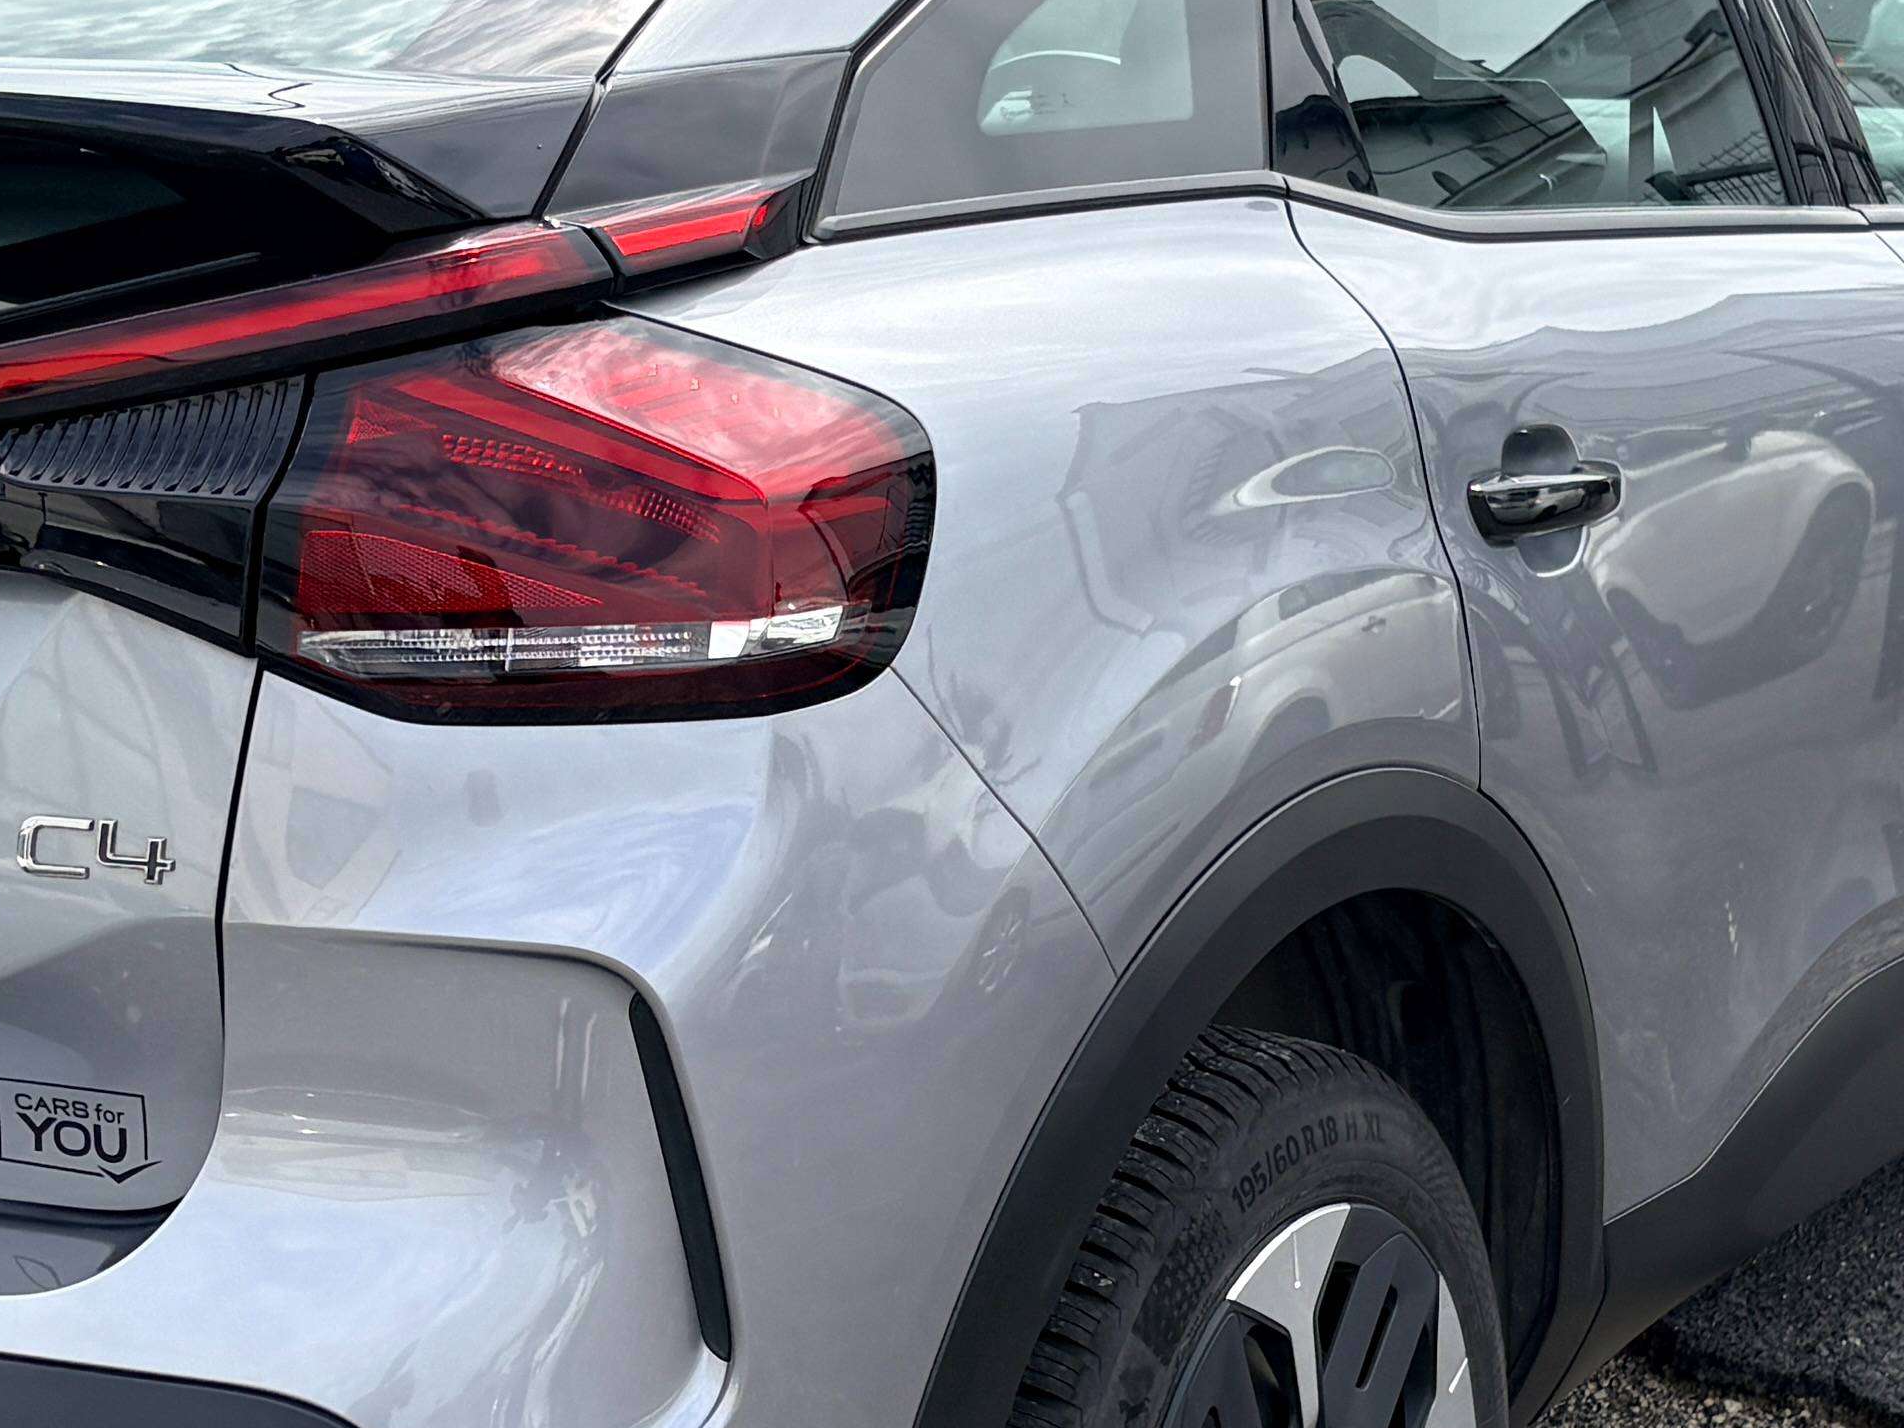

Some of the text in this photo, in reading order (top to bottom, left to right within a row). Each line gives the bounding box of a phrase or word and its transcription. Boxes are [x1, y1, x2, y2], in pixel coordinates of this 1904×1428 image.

[16, 814, 176, 885] C4
[14, 1092, 125, 1125] CARS for
[15, 1112, 128, 1164] YOU
[1232, 1134, 1301, 1214] 195/60
